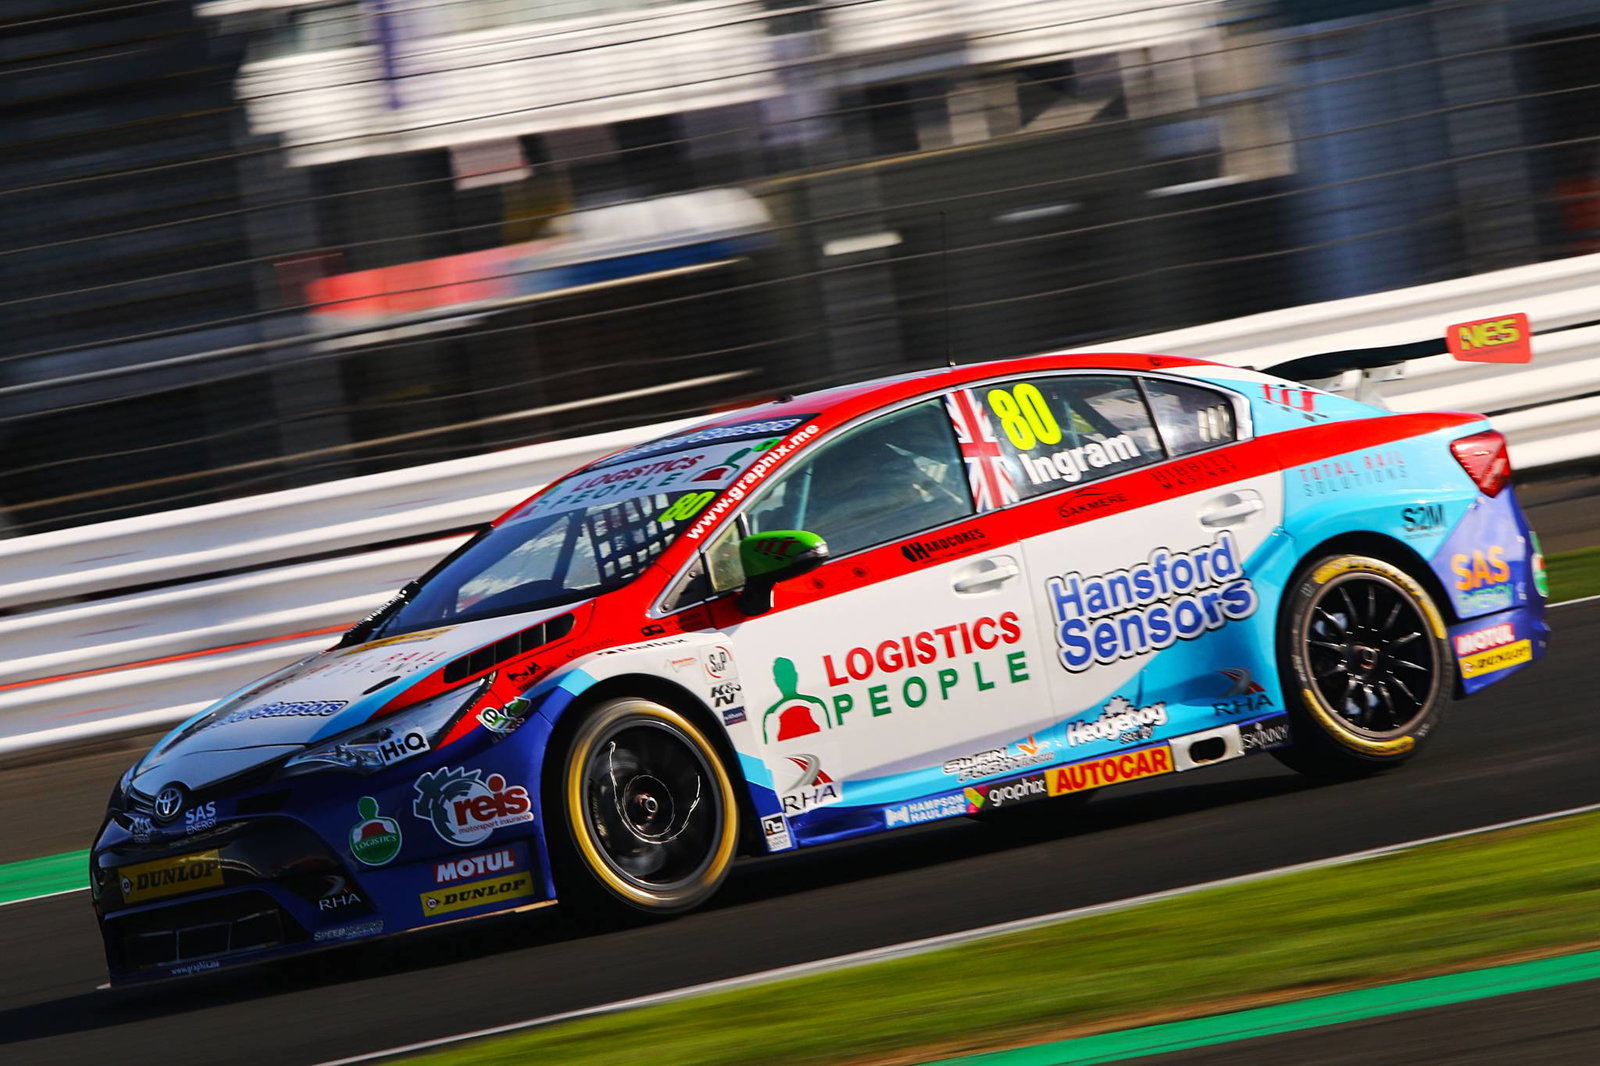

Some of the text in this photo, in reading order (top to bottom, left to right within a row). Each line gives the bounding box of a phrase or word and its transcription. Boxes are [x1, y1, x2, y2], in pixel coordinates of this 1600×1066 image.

[1459, 318, 1519, 350] NES
[988, 383, 1062, 450] 80
[571, 454, 706, 492] LOGISTICS
[1018, 433, 1141, 485] Ingram
[687, 424, 820, 540] www.graphix.me
[1049, 535, 1238, 622] Hansford
[1451, 545, 1511, 591] SAS
[1059, 579, 1253, 668] Sensors
[823, 611, 1021, 687] LOGISTICS
[832, 650, 1030, 726] PEOPLE
[1212, 693, 1274, 716] RHA
[380, 732, 427, 763] HiQ
[1055, 748, 1169, 795] AUTOCAR
[453, 776, 530, 826] reis
[783, 785, 837, 813] RHA
[988, 776, 1047, 807] graphix
[185, 801, 217, 825] SAS
[186, 817, 217, 835] ENERGY
[354, 832, 399, 850] LOGISTICS
[136, 860, 219, 890] DUNLOP
[436, 850, 515, 883] MOTUL
[319, 893, 361, 910] RHA
[443, 879, 526, 905] DUNLOP
